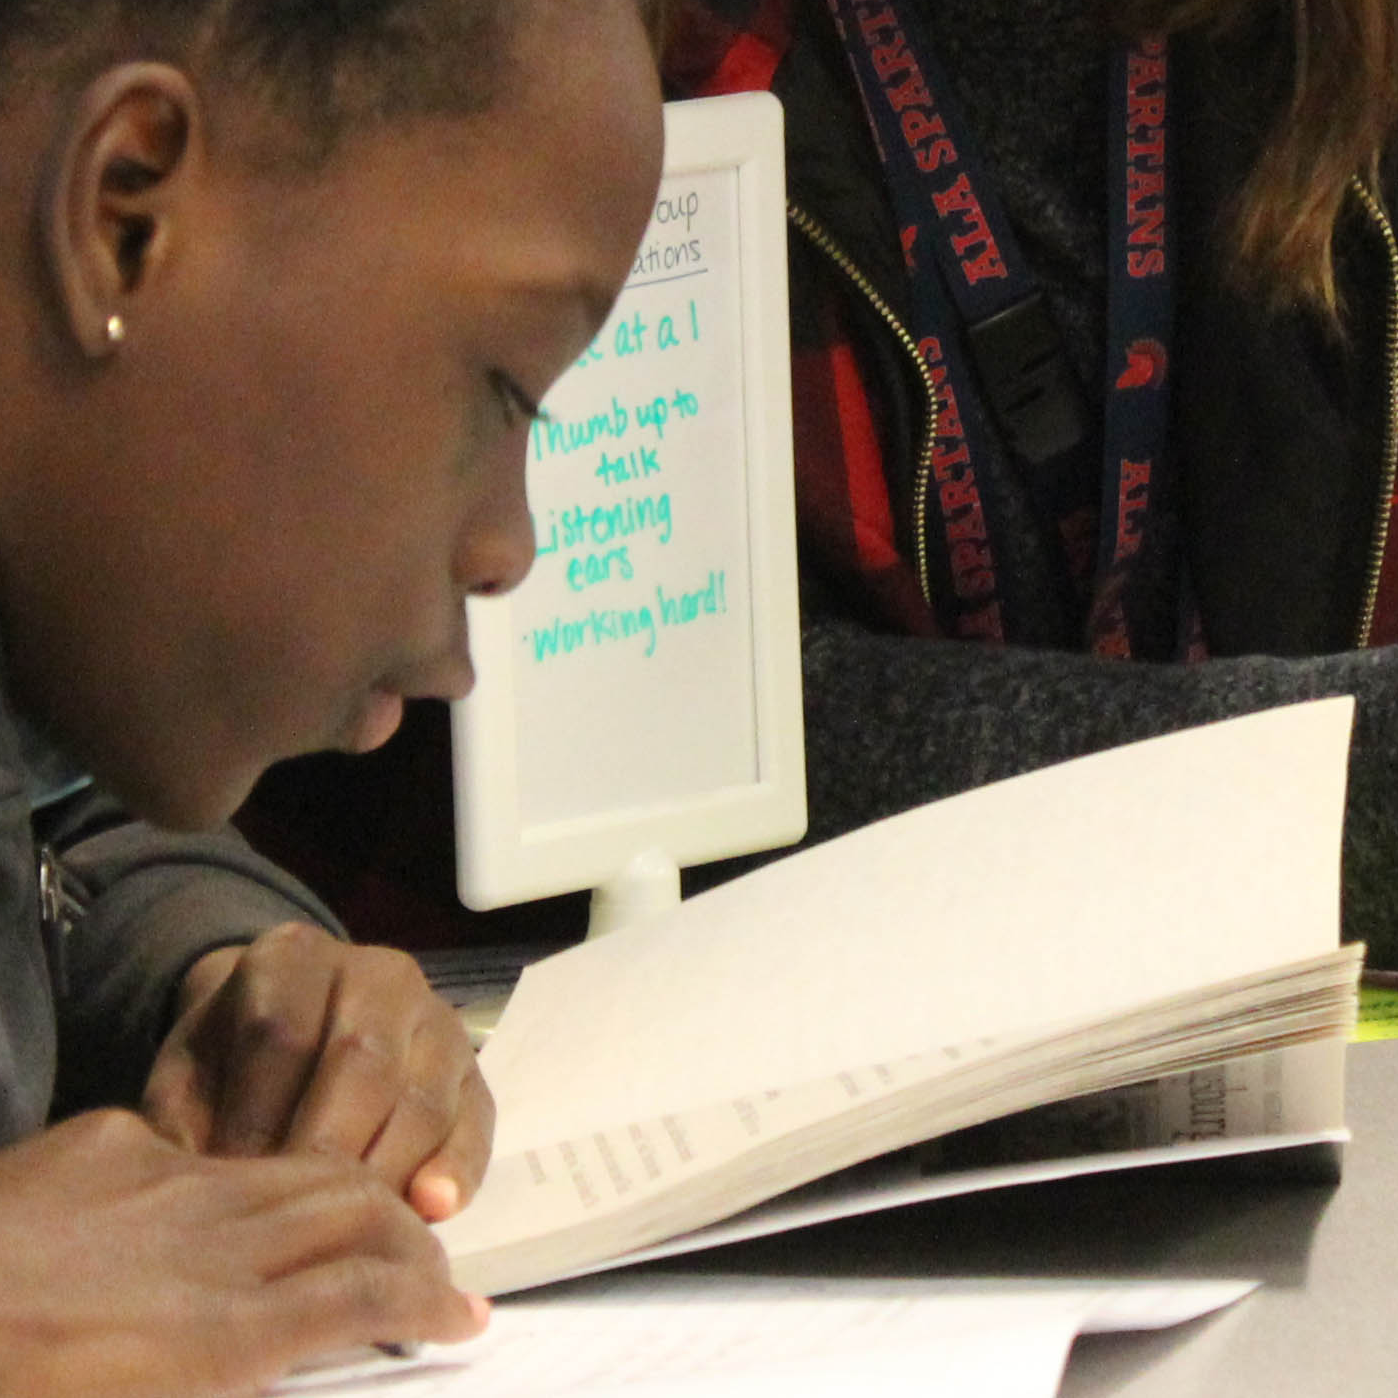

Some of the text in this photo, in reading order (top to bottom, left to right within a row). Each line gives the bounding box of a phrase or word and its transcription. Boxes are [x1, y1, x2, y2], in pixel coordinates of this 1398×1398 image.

[655, 191, 699, 233] oup
[932, 173, 1007, 286] ALA
[632, 239, 702, 275] ations
[614, 311, 647, 357] at
[658, 315, 680, 351] a
[531, 388, 699, 462] Thumb up to
[595, 445, 661, 487] talk
[566, 545, 634, 592] ears
[655, 569, 727, 627] hard!
